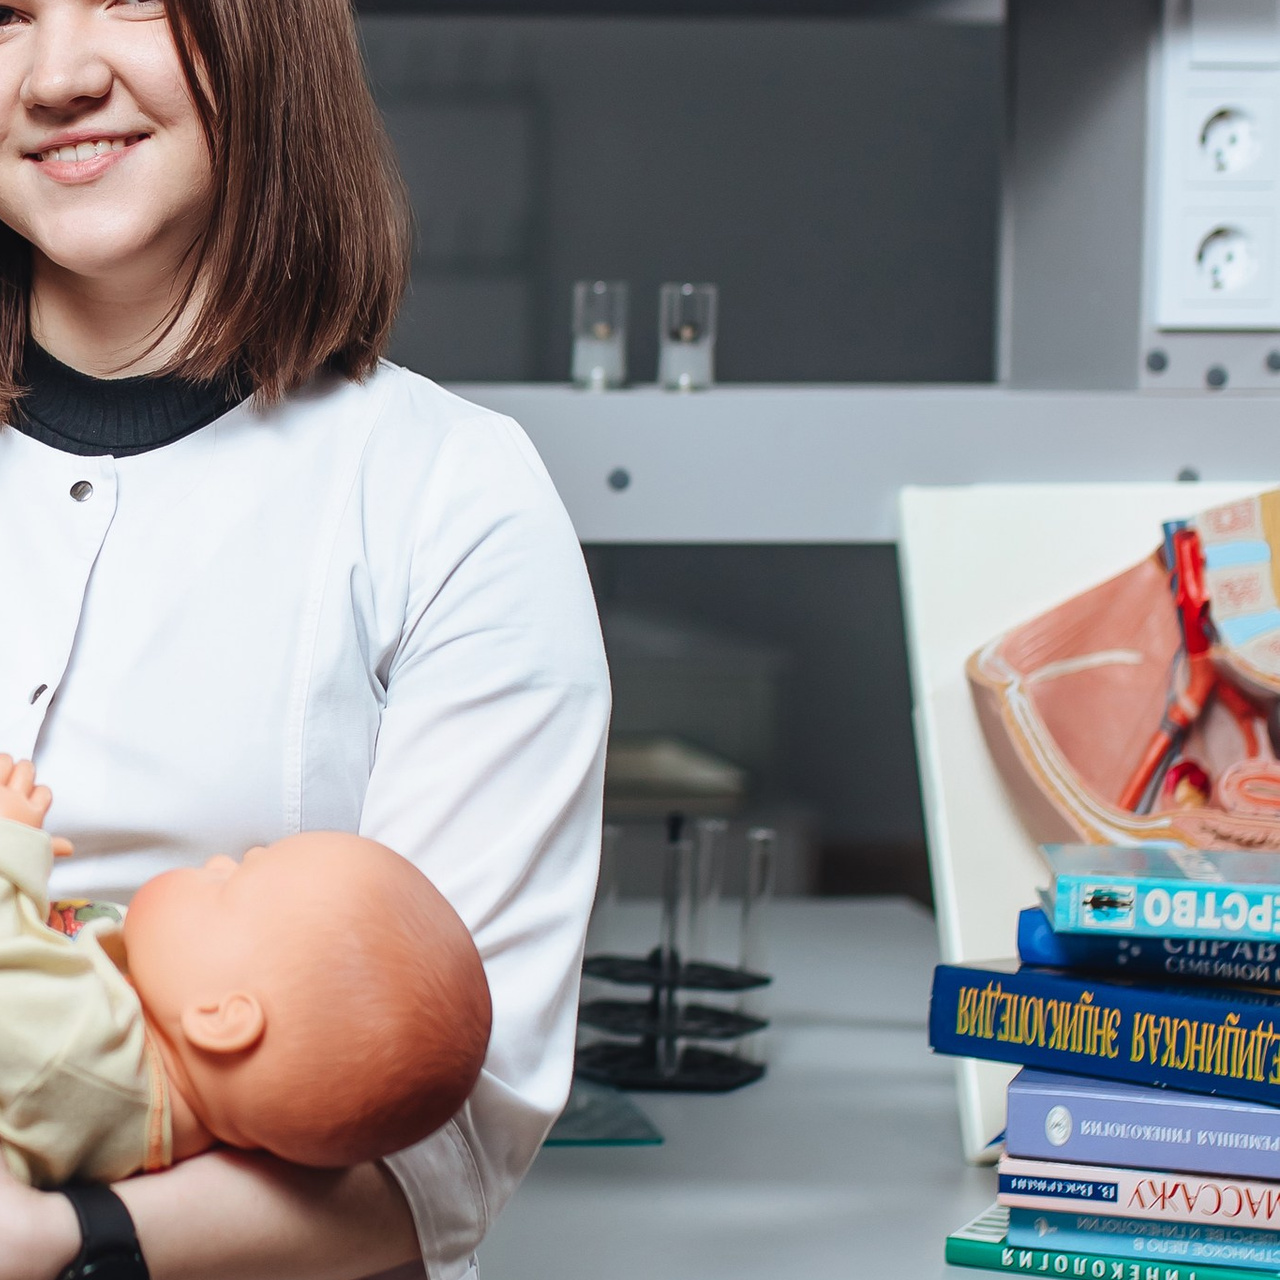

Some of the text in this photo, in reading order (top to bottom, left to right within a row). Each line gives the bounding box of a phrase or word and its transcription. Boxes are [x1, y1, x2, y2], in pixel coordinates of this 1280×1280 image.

[1165, 956, 1270, 983] СЕМЕЙНОЙ
[956, 980, 1121, 1059] ЭНЦИКЛОПЕДИЯ
[1080, 1120, 1192, 1143] ГИНЕКОЛОГИЯ
[1133, 1236, 1144, 1251] В
[1147, 1238, 1190, 1255] ДЕЛО
